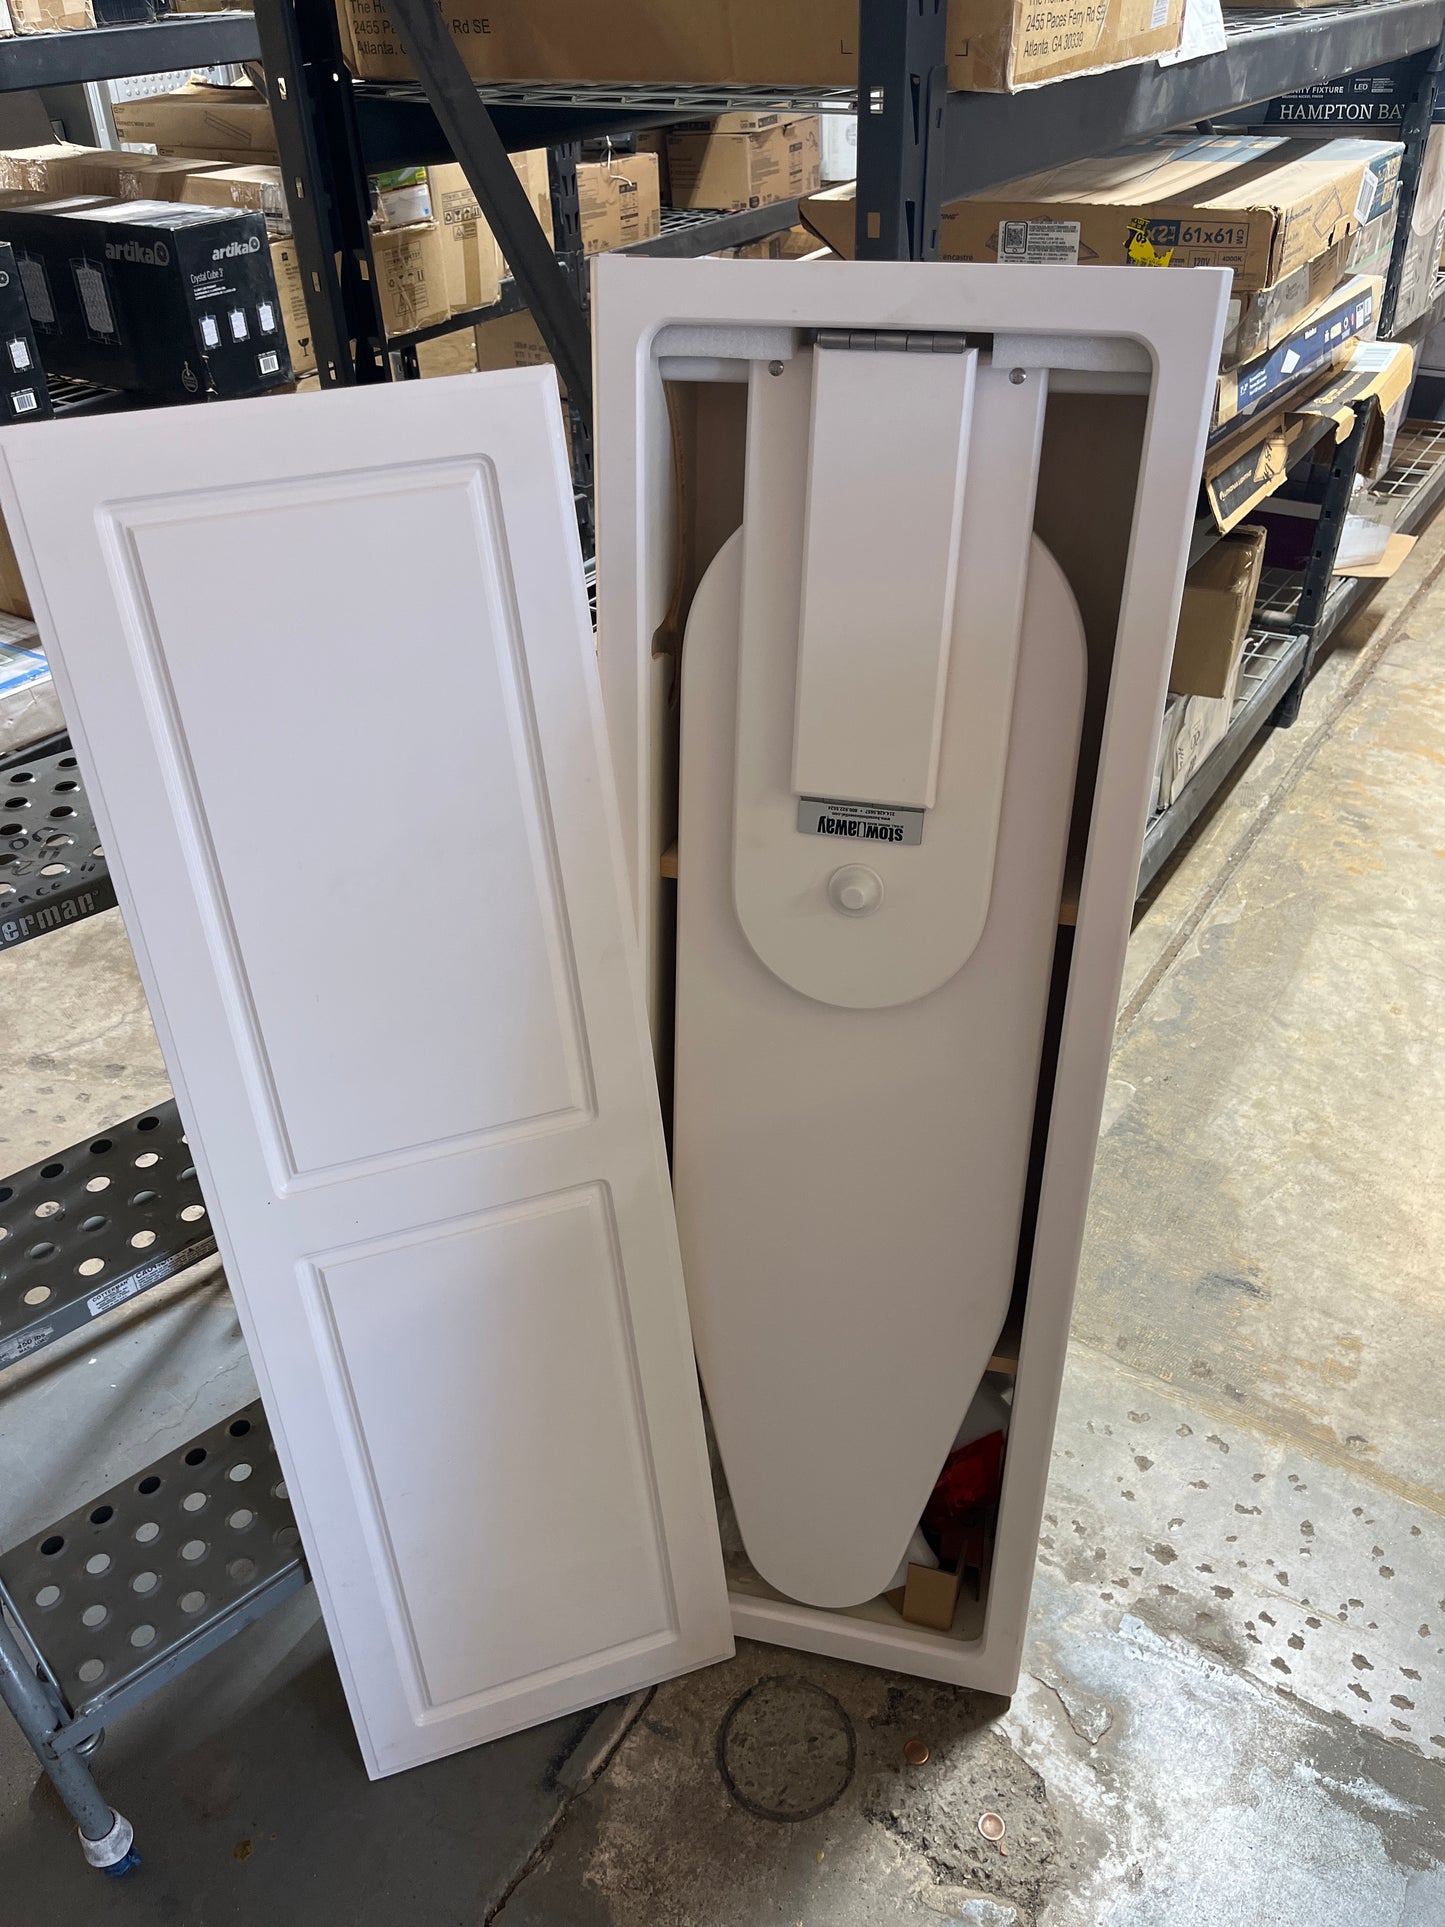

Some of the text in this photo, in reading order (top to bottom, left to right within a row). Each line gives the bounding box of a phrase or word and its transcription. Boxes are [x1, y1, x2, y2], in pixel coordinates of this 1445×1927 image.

[354, 20, 380, 34] 2455
[453, 19, 470, 34] Rd
[473, 19, 491, 34] SE
[1026, 12, 1046, 33] 2455
[1046, 11, 1067, 29] Paces
[1068, 8, 1085, 28] Ferry
[1086, 6, 1096, 23] Rd
[357, 40, 398, 55] Atlanta,
[1023, 31, 1084, 58] Atlanta, GA 30339
[1312, 86, 1344, 94] FIXTURE
[1354, 83, 1368, 91] LED
[1280, 103, 1404, 120] HAMPTON BA
[1182, 226, 1234, 244] 61x61
[104, 240, 156, 265] artika
[212, 241, 251, 261] artika
[1222, 255, 1242, 263] 4000K
[0, 892, 96, 946] erman
